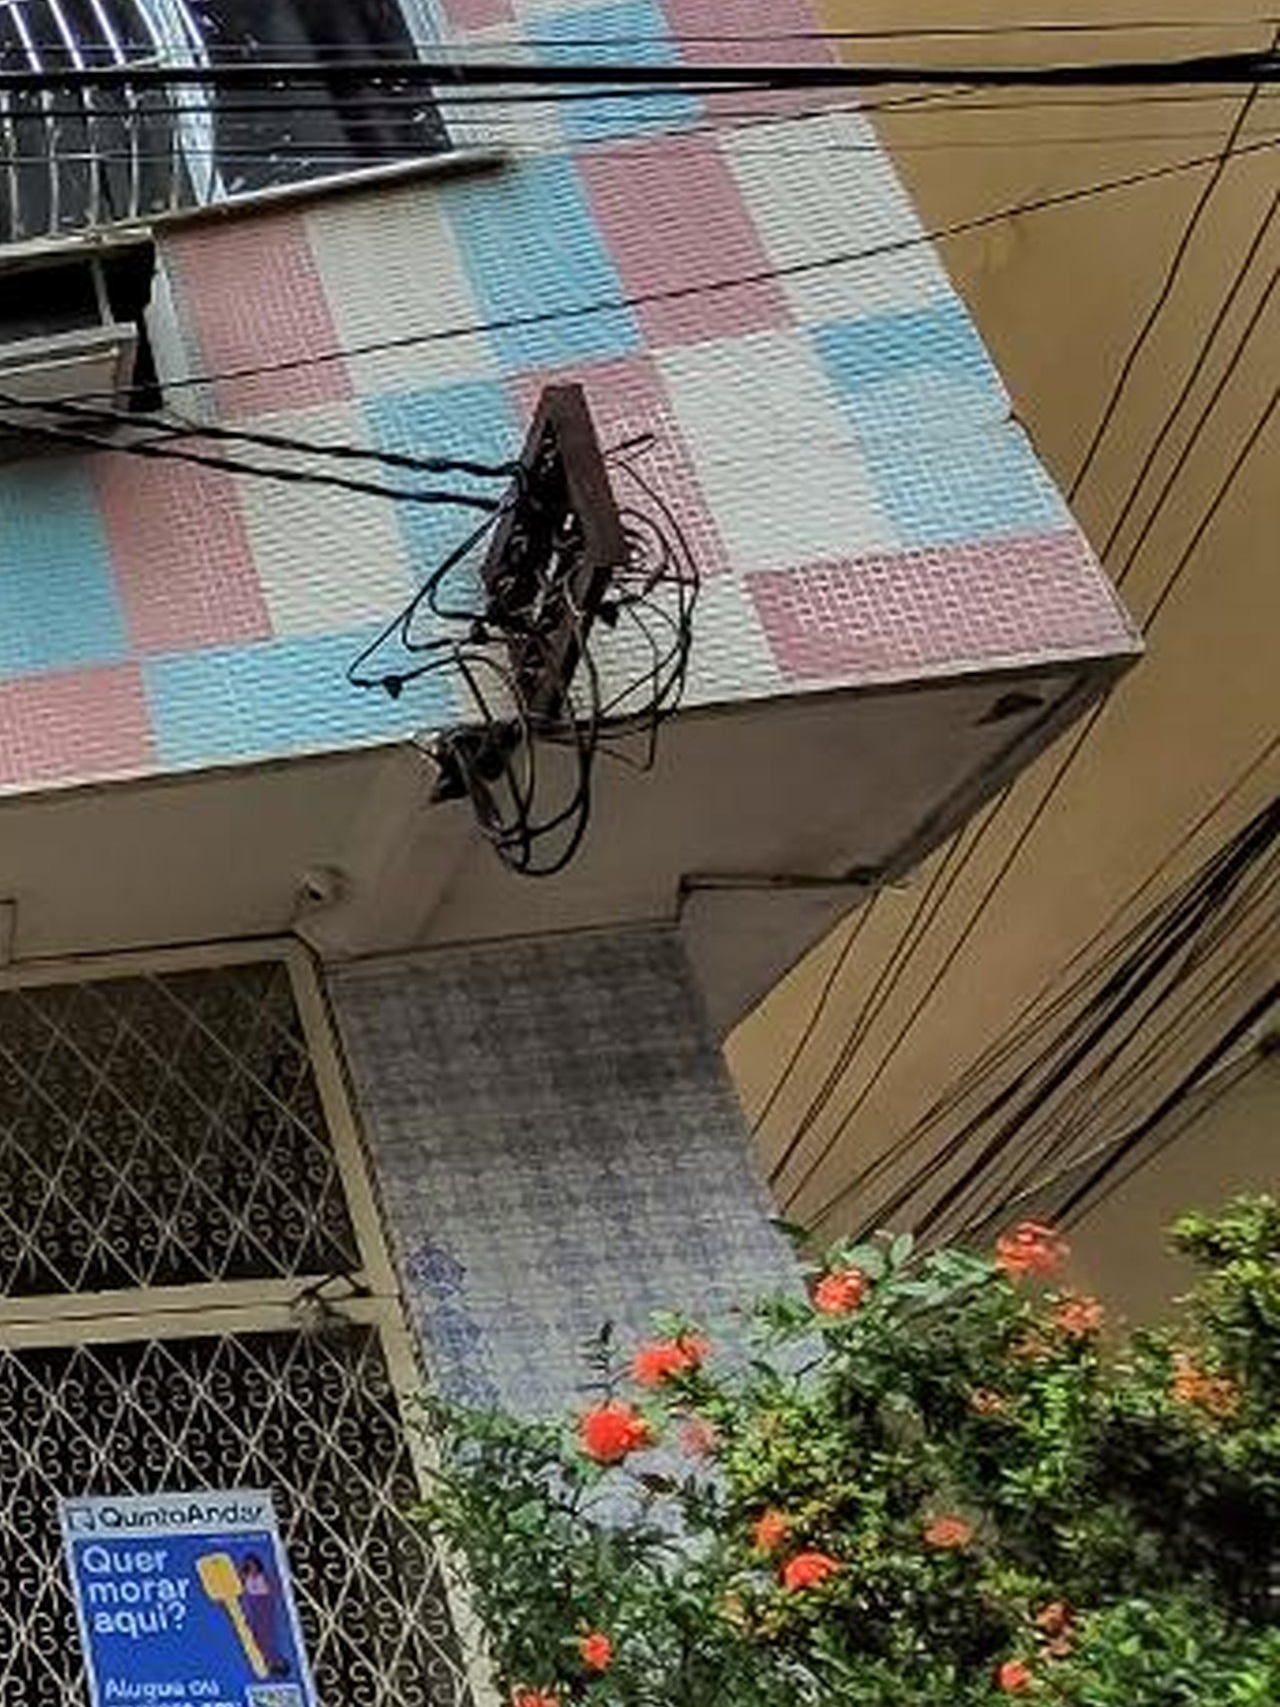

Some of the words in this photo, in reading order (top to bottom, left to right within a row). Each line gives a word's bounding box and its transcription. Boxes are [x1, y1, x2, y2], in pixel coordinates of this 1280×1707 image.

[99, 1503, 263, 1529] QuintoAndar
[82, 1546, 168, 1573] Quer
[89, 1577, 189, 1604] morar
[93, 1601, 187, 1639] aqui?
